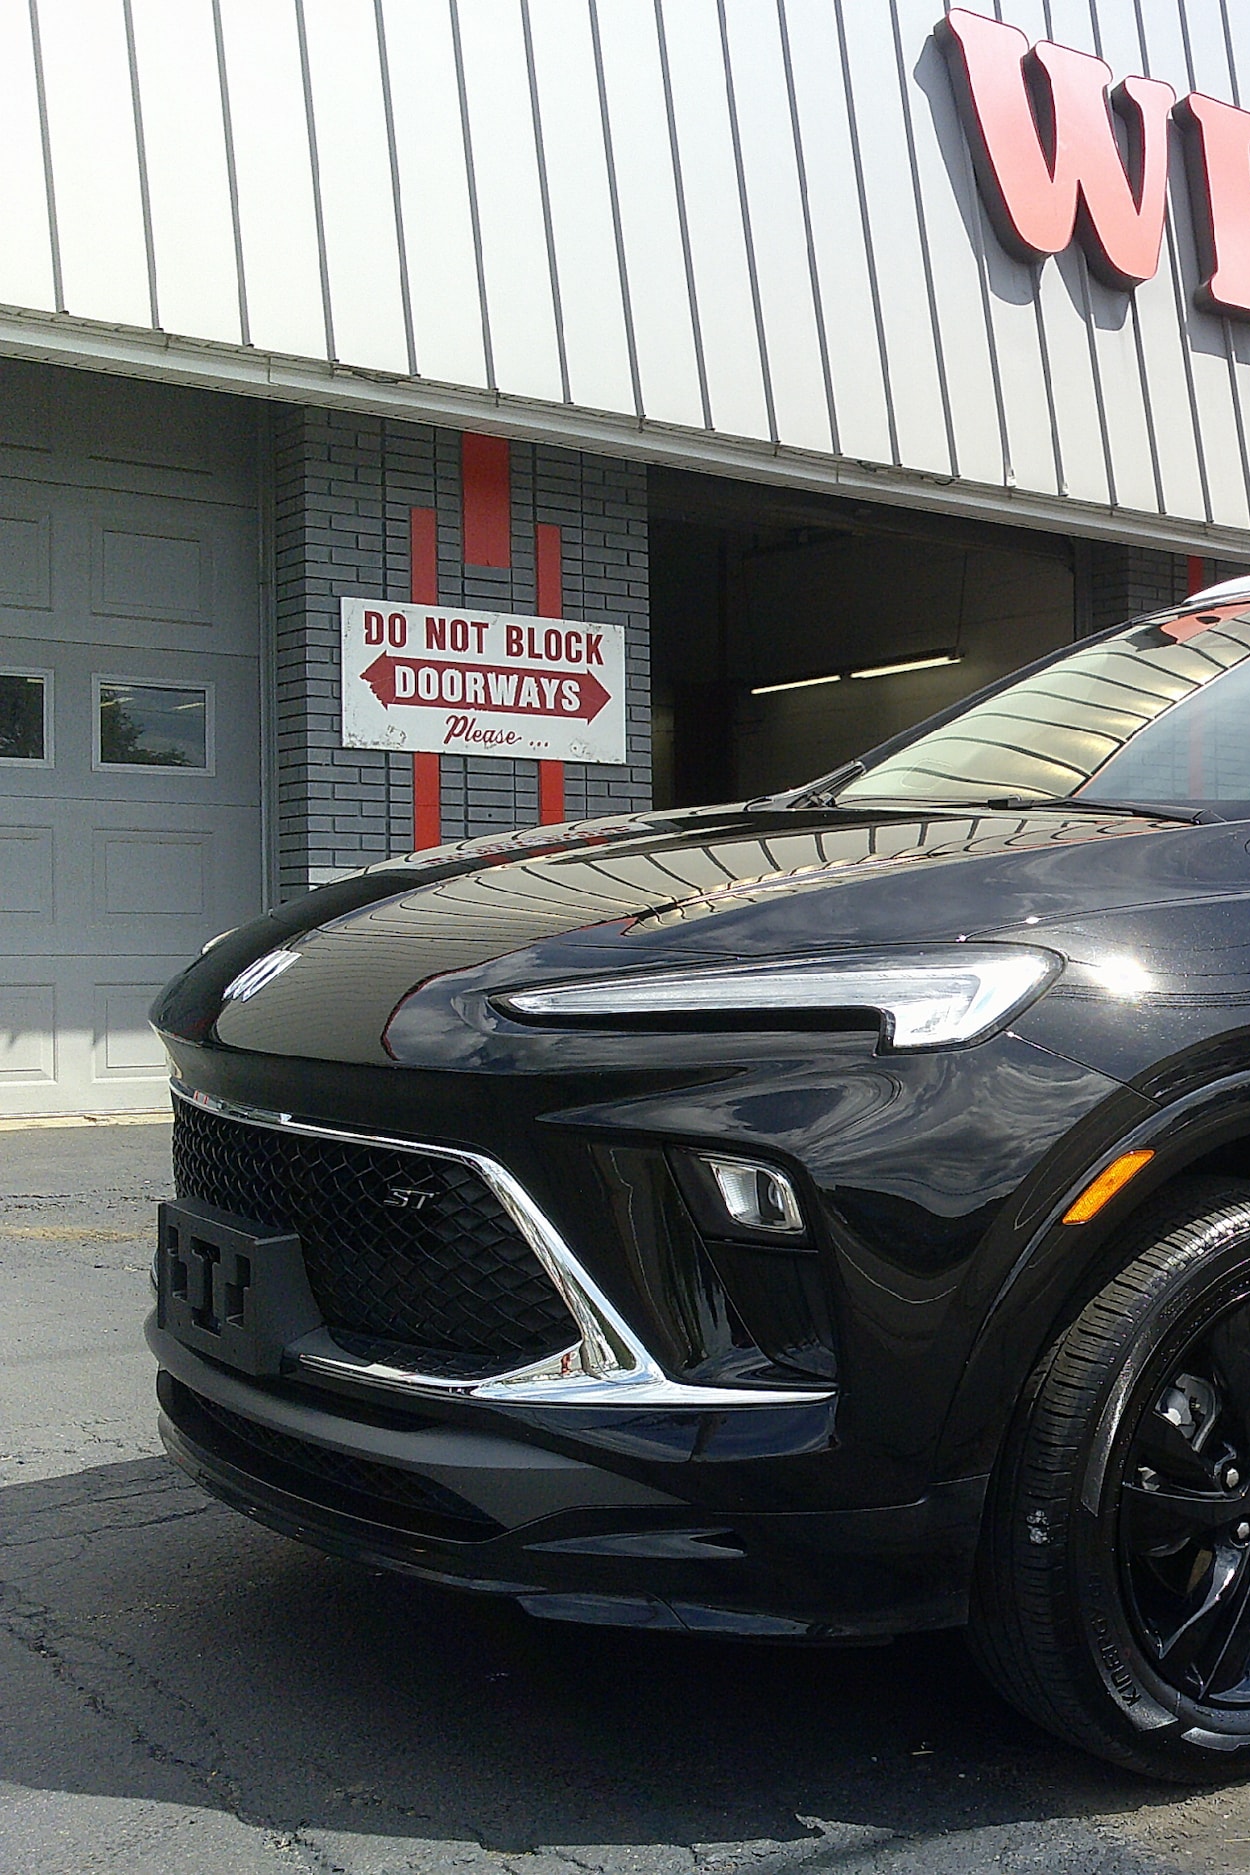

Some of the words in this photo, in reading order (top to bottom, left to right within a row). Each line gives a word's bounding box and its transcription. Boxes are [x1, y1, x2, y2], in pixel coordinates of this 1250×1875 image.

[364, 610, 407, 648] DO
[425, 616, 490, 655] NOT
[505, 624, 605, 666] BLOCK
[395, 664, 582, 712] DOORWAYS
[443, 714, 523, 745] Please
[383, 1185, 441, 1211] ST
